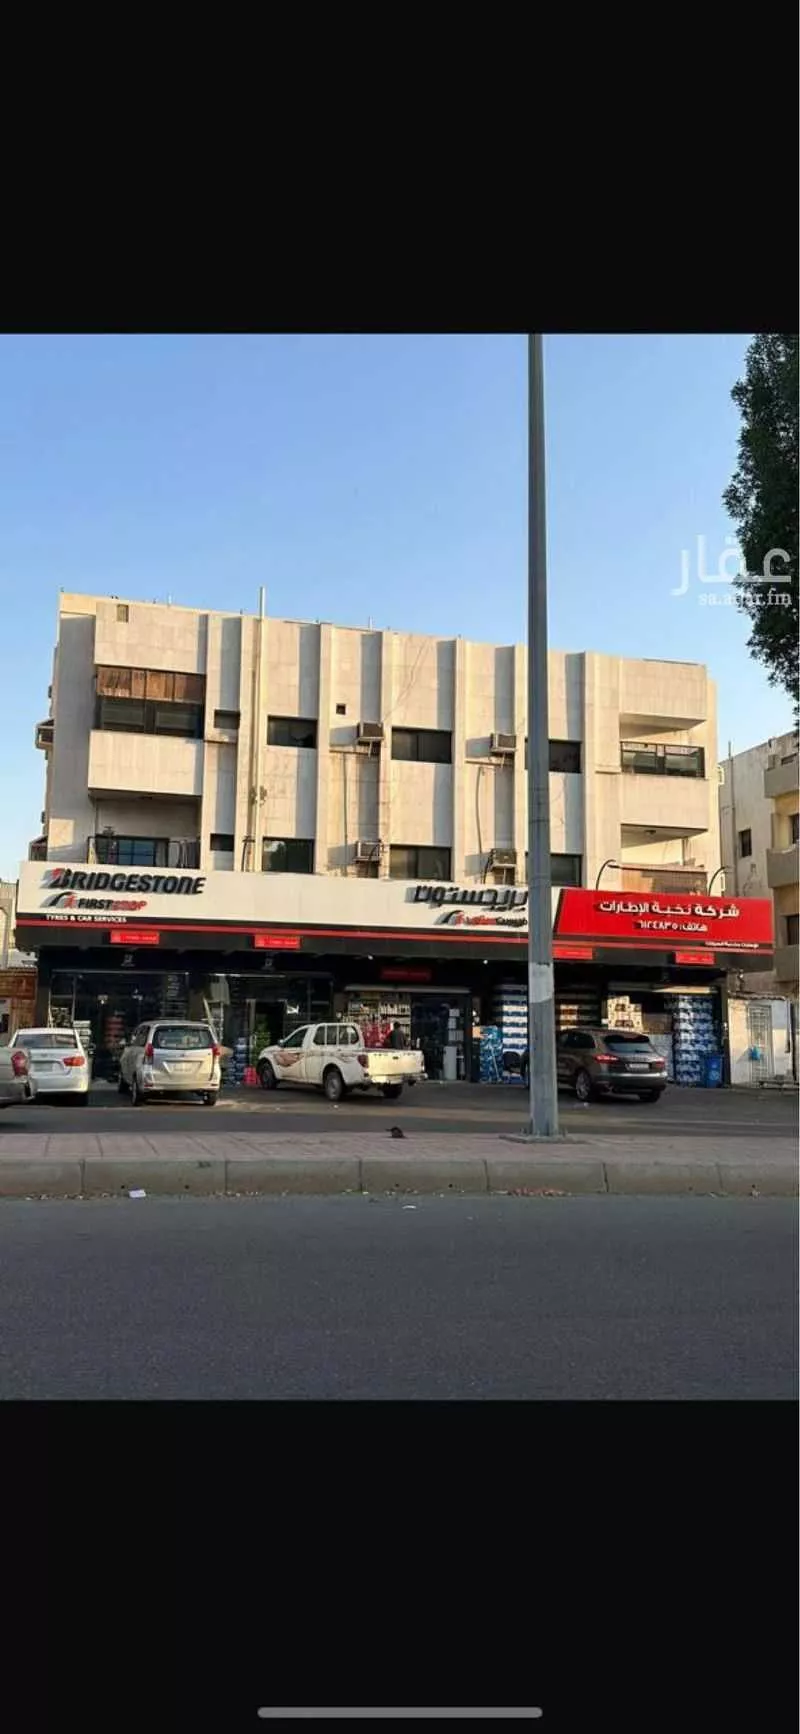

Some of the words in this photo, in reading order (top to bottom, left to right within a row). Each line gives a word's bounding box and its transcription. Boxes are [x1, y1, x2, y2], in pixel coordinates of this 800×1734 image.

[46, 867, 206, 895] BRIDGESTONE
[77, 915, 92, 923] CAR
[693, 902, 741, 919] شركة
